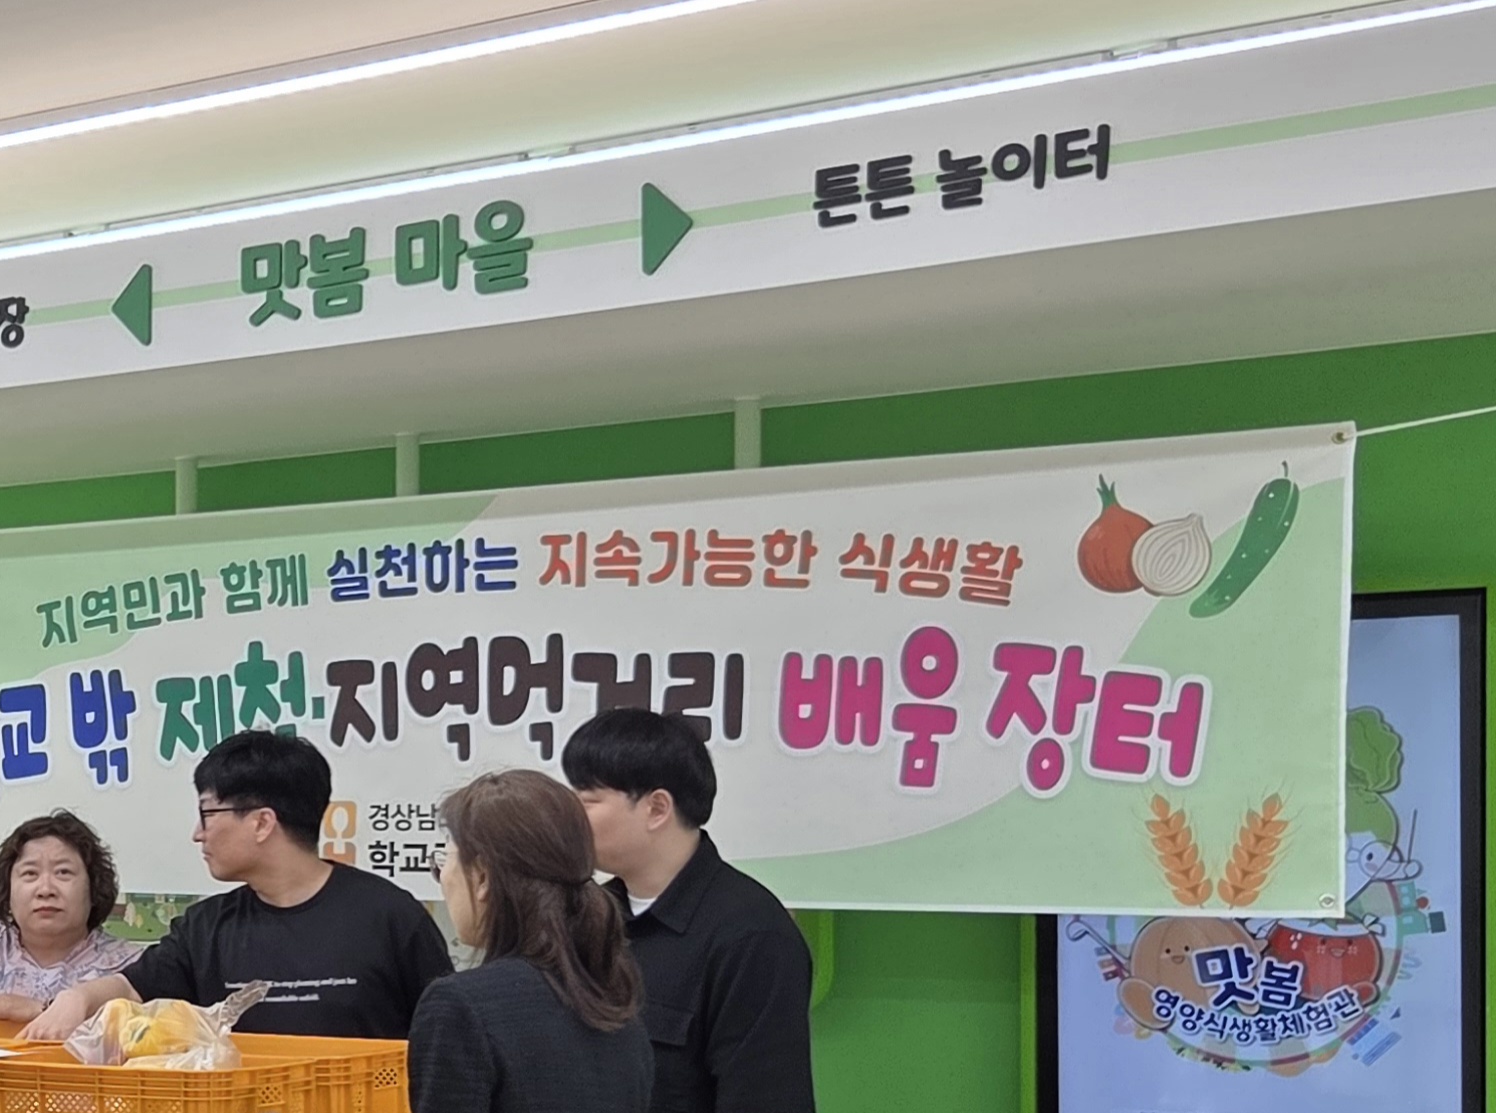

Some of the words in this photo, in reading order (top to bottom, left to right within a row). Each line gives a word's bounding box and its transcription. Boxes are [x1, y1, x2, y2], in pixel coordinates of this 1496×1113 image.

[813, 155, 915, 228] 튼튼
[936, 124, 1110, 210] 놀이터
[241, 226, 369, 327] 맛봄
[395, 199, 534, 295] 마을
[36, 569, 205, 648] 지역민과
[221, 553, 309, 615] 함께
[326, 537, 519, 602] 실천하는
[538, 528, 818, 589] 지속가능한
[839, 532, 1023, 607] 식생활
[69, 669, 137, 785] 밖
[779, 625, 959, 787] 배움
[985, 642, 1204, 790] 장터
[368, 803, 439, 832] 경상남
[368, 841, 446, 877] 학교
[1154, 988, 1360, 1041] 영양식생활체험관
[1195, 947, 1300, 1007] 맛봄
